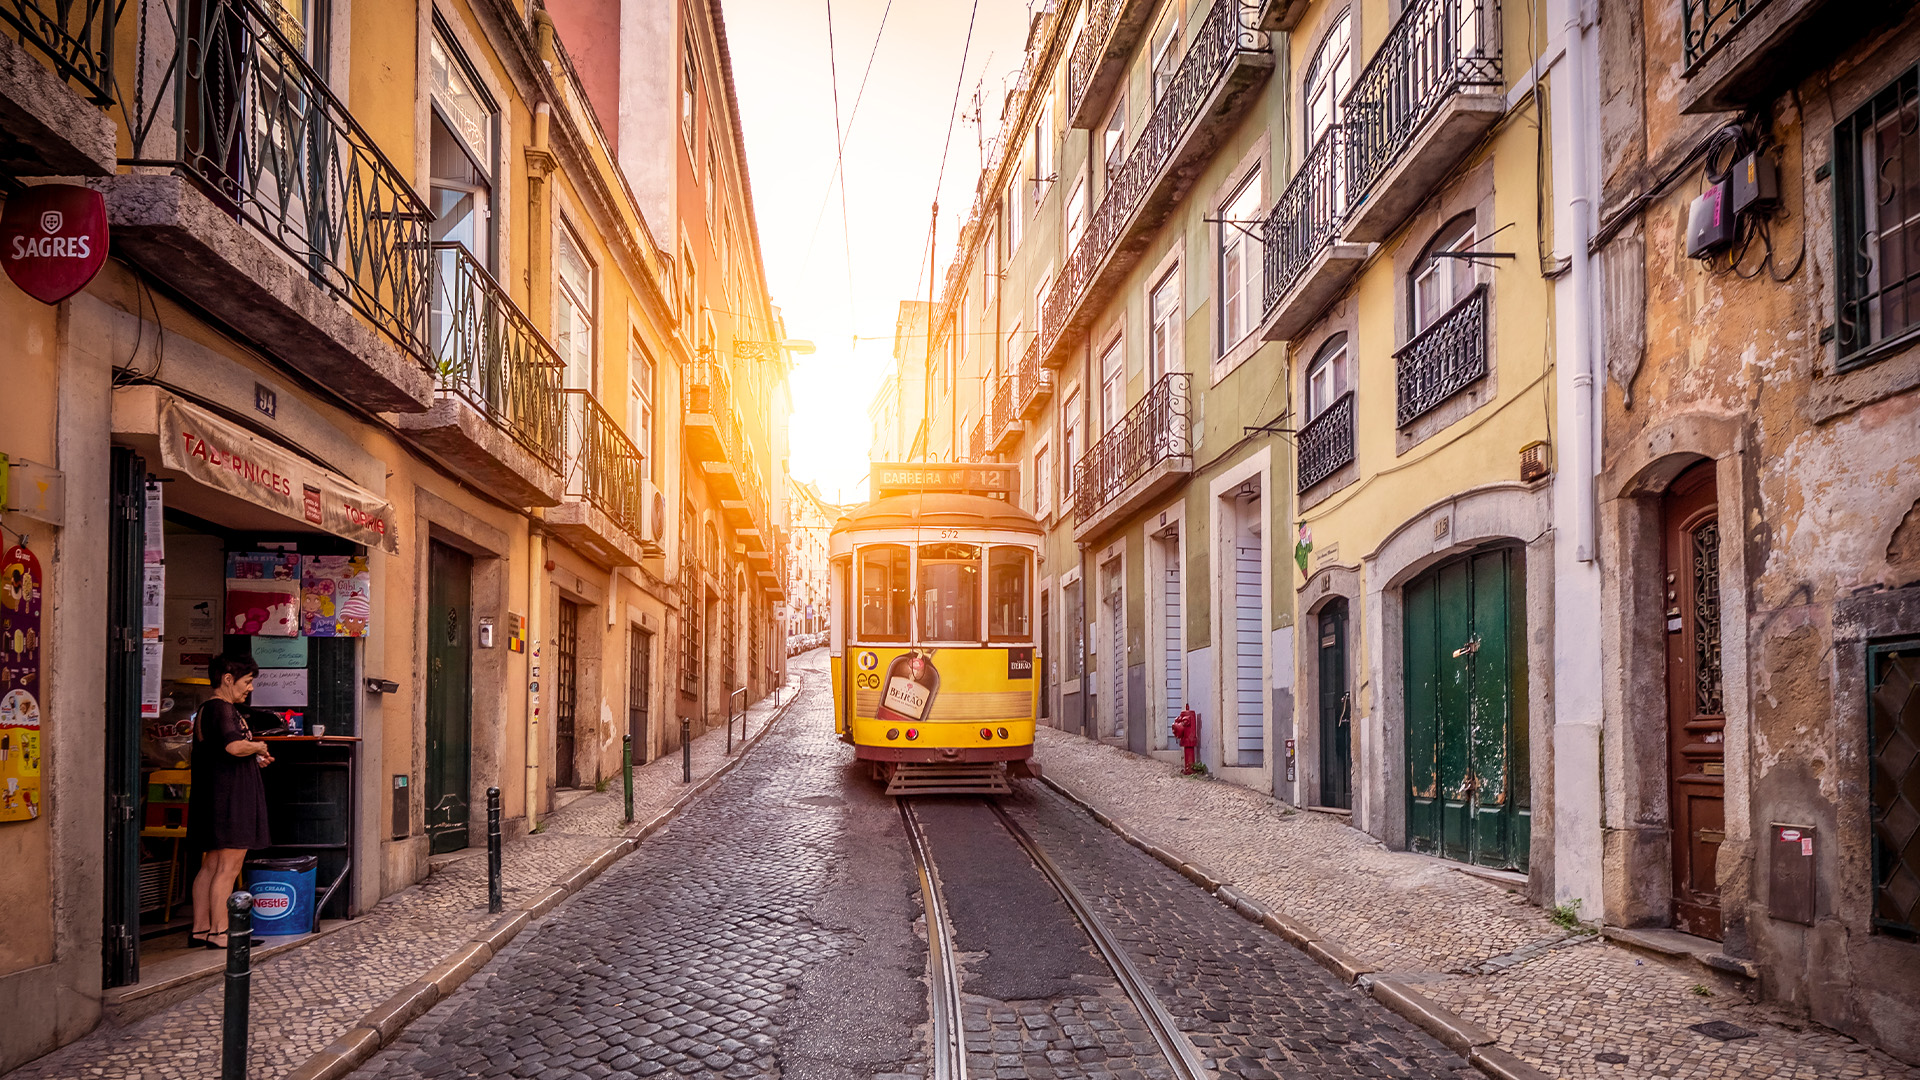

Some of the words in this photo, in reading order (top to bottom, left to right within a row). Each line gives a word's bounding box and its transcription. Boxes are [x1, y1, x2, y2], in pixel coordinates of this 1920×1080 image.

[11, 235, 91, 260] SAGRES
[883, 472, 942, 485] CARREIRA
[979, 470, 1001, 486] 12
[941, 530, 959, 539] 572
[889, 687, 924, 707] BEIRÃO
